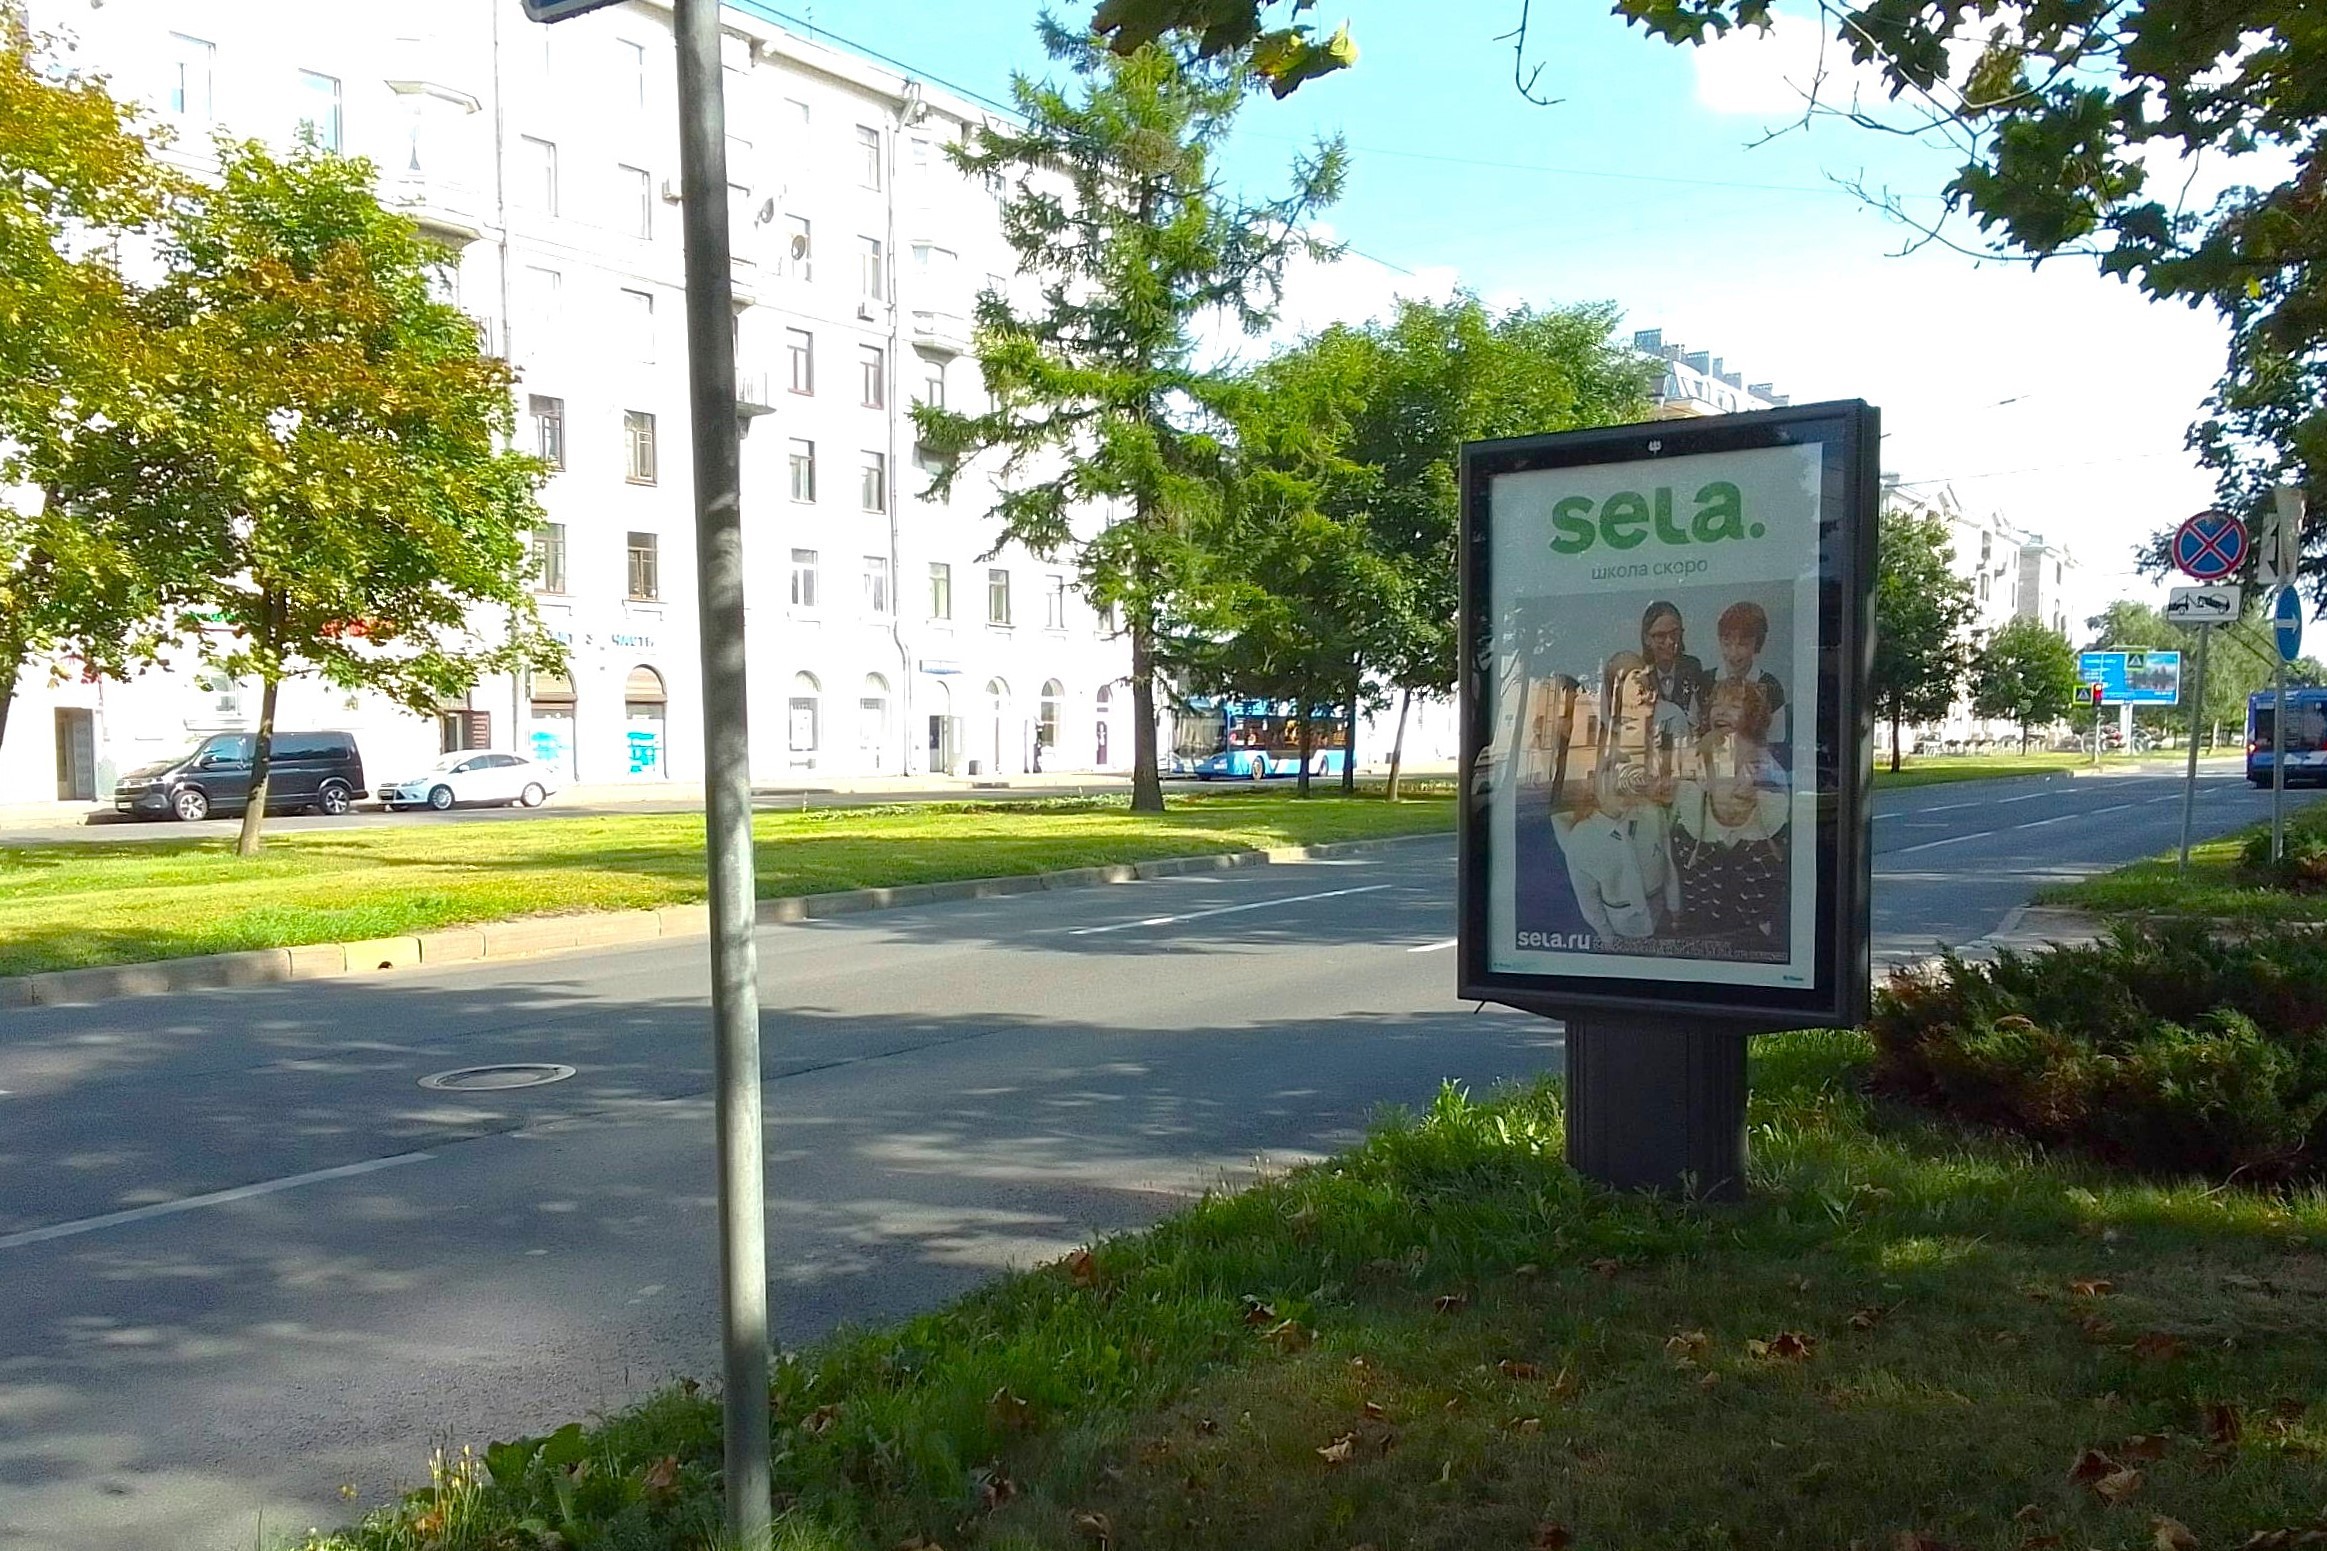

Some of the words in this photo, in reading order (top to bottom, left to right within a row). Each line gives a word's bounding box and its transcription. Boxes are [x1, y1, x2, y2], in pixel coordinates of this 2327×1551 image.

[1591, 563, 1649, 580] школа
[1653, 559, 1708, 579] скоро
[1517, 931, 1591, 950] sela.ru
